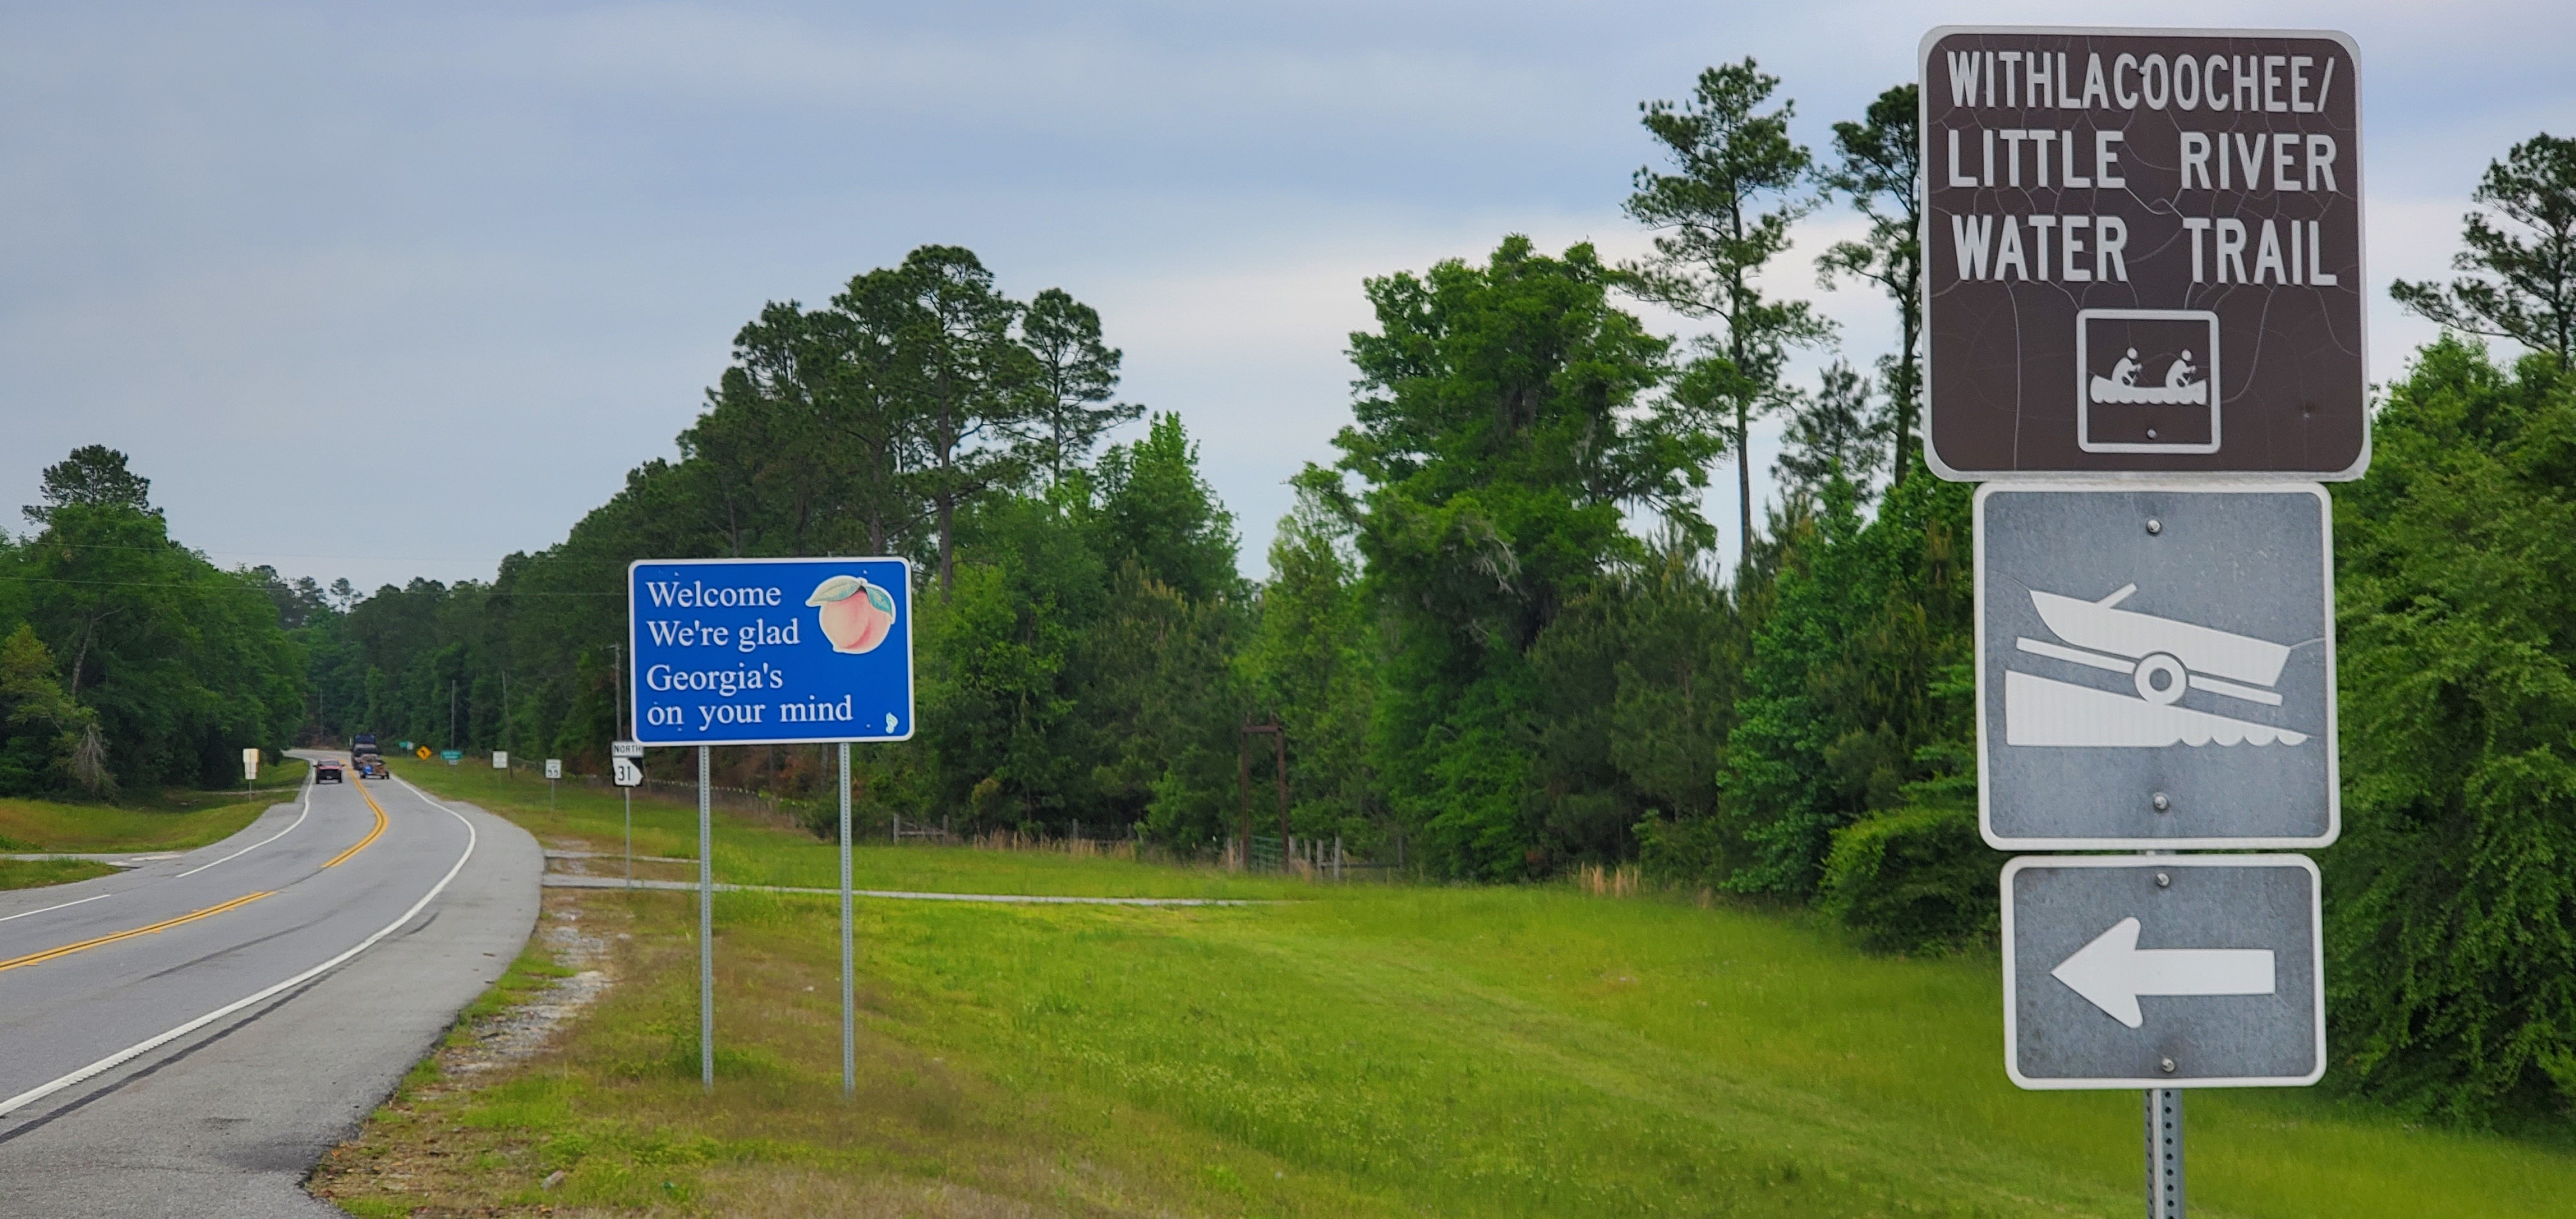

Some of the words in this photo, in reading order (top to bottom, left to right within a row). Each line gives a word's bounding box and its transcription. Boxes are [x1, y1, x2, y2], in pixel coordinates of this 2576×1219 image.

[1947, 51, 2334, 113] WITHLACOOCHEE/
[1947, 129, 2126, 188] LITTLE
[2180, 132, 2338, 192] RIVER
[1951, 215, 2128, 282] WATER
[2182, 218, 2338, 286] TRAIL
[646, 580, 782, 608] Welcome
[647, 620, 729, 647] We're
[738, 617, 800, 652] glad
[646, 662, 783, 696] Georgia's
[647, 705, 684, 726] on
[698, 703, 766, 731] your
[779, 694, 854, 723] mind
[613, 745, 641, 754] NORTH
[618, 765, 631, 781] 31
